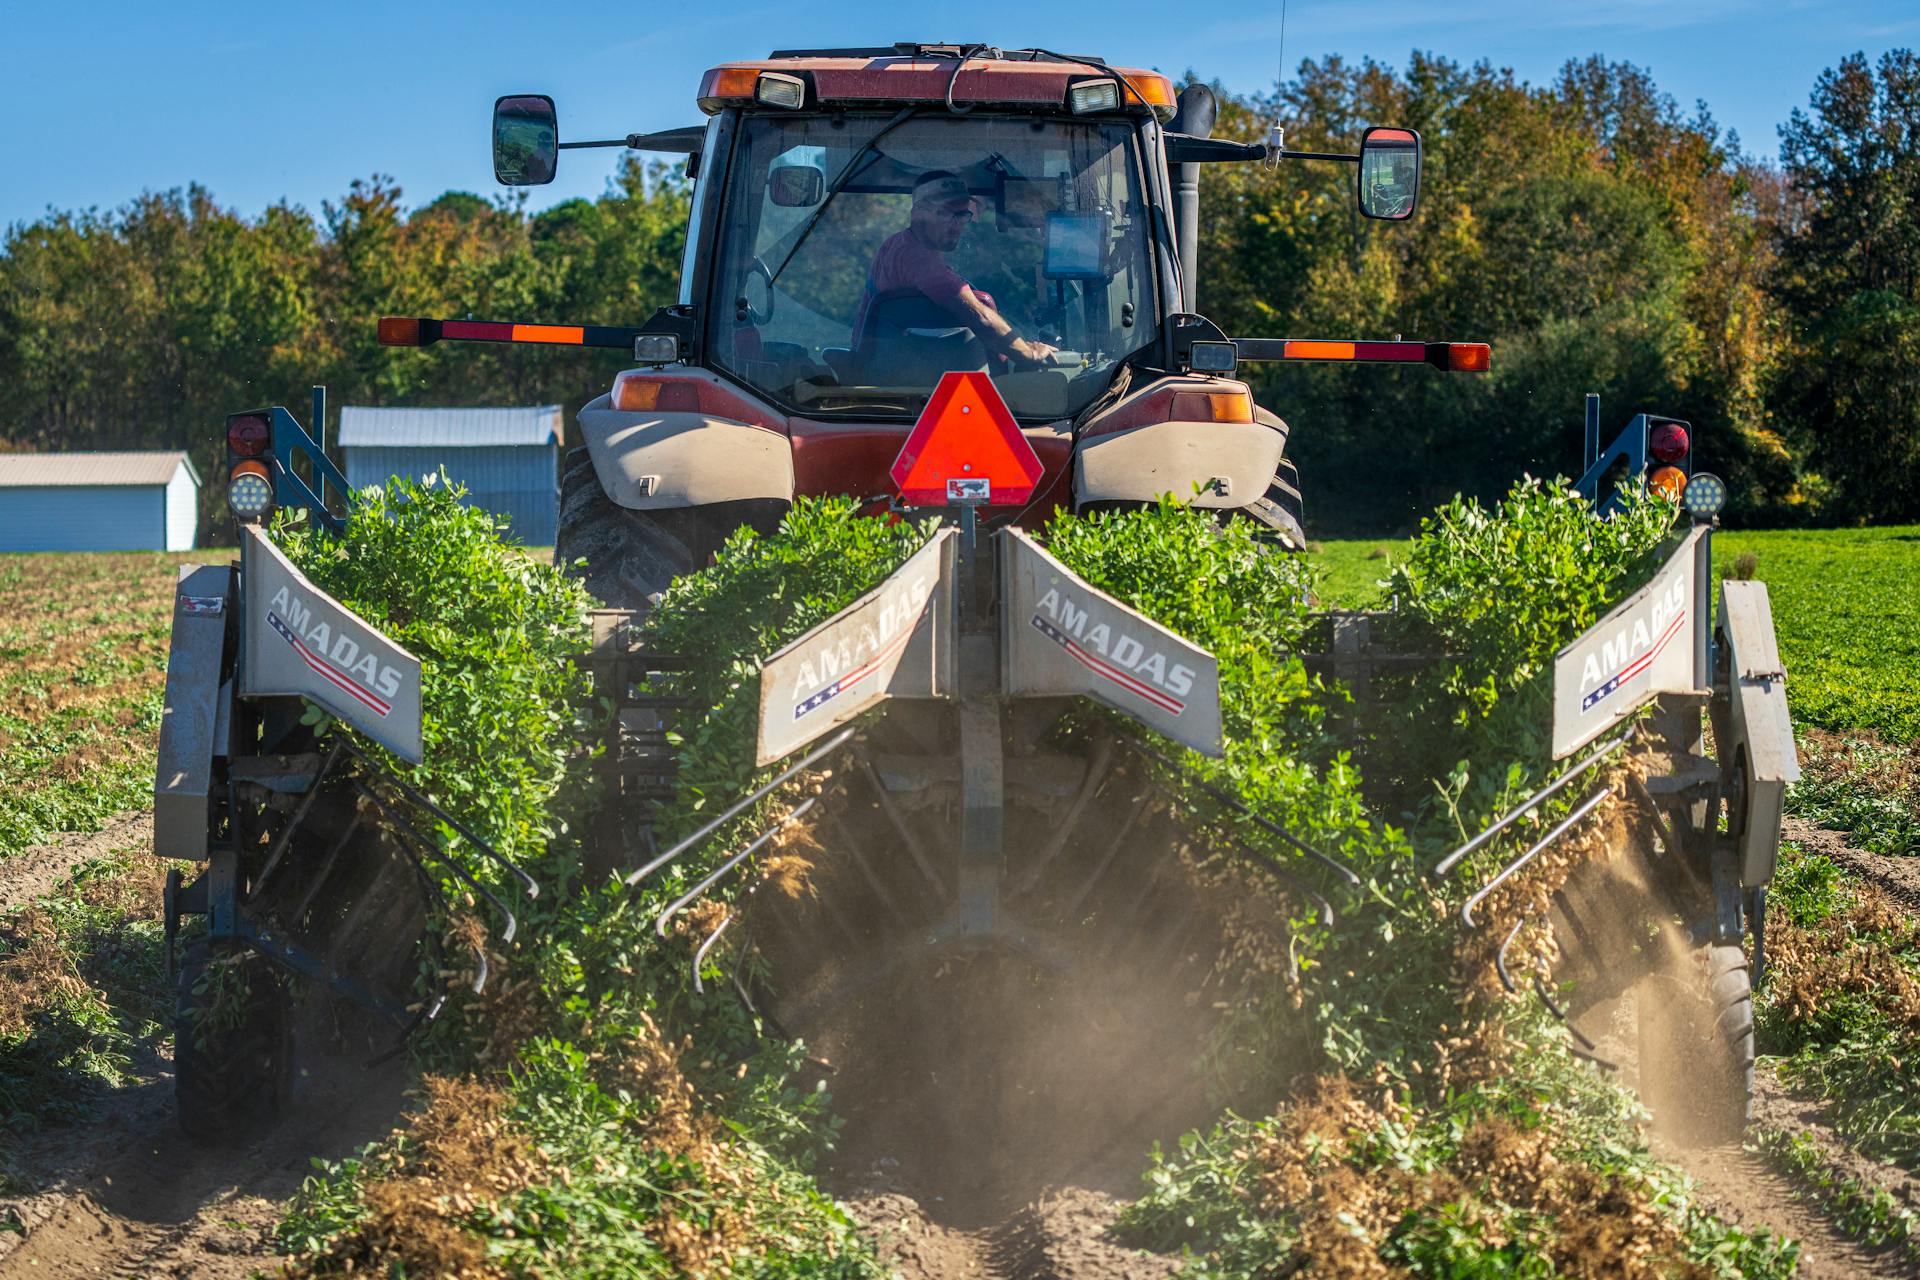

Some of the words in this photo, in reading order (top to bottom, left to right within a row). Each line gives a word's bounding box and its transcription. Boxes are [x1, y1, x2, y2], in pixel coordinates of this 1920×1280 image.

[270, 585, 402, 698] AMADAS
[792, 576, 926, 700] AMADAS
[1036, 588, 1196, 697] AMADAS
[1579, 574, 1685, 693] AMADAS
